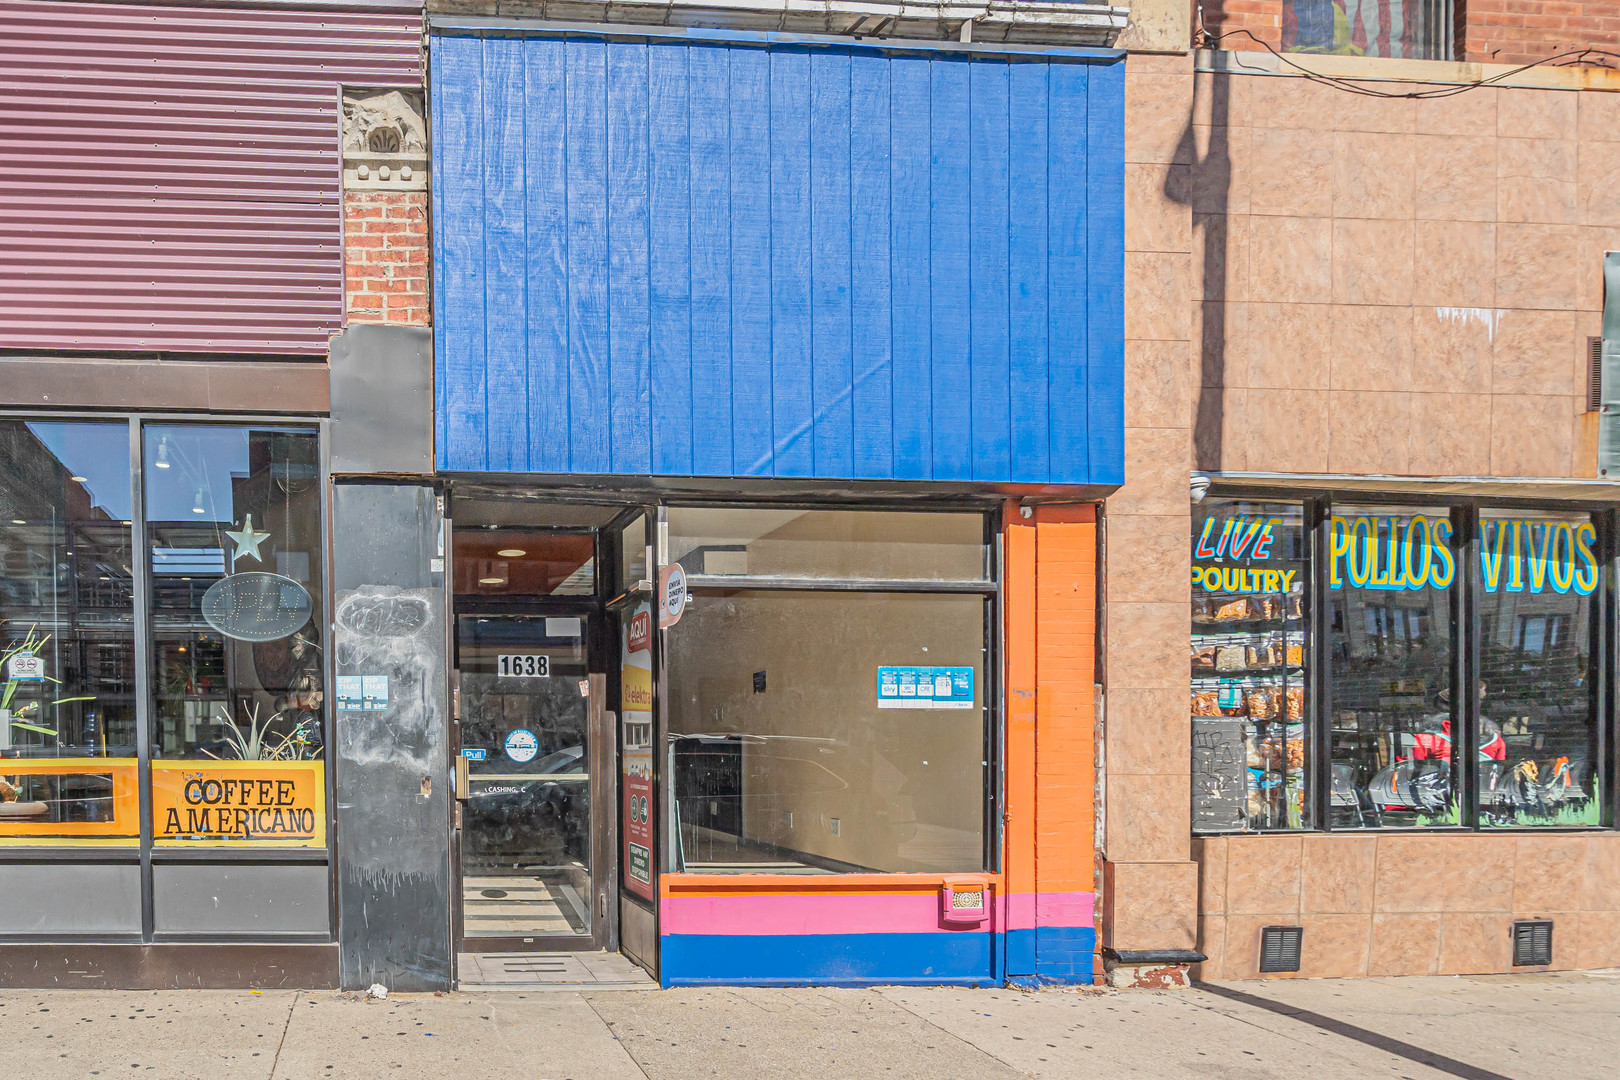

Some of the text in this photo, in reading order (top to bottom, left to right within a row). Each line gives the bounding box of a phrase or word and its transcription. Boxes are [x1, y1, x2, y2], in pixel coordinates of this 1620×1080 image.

[1195, 515, 1284, 560] LIVE
[1330, 514, 1599, 596] POLLOS VIVOS
[1191, 566, 1296, 594] POULTRY
[213, 592, 300, 622] OPEN
[630, 613, 647, 640] AQUÍ
[501, 656, 548, 676] 1638
[631, 685, 651, 705] elektra
[465, 751, 482, 759] Pull
[184, 779, 296, 806] COFFEE
[163, 807, 315, 837] AMERICANO
